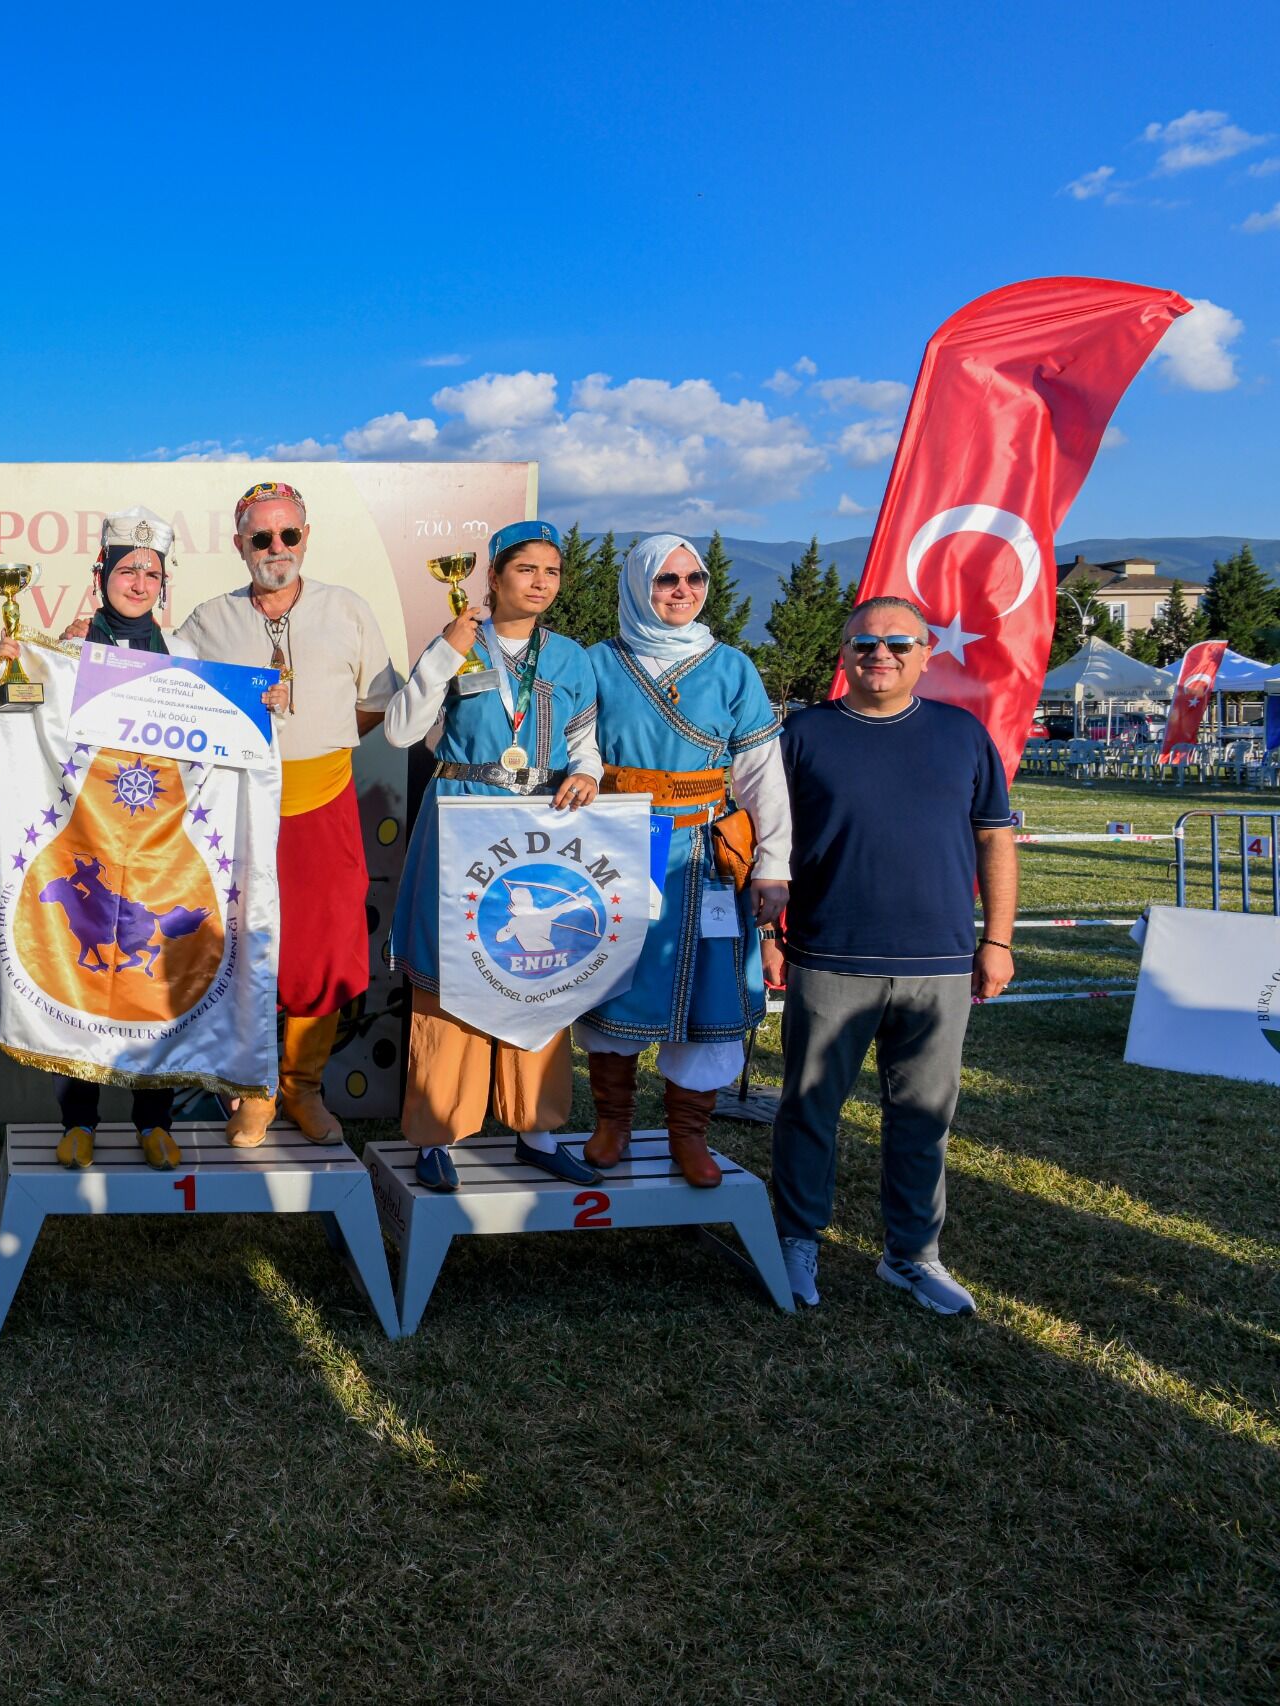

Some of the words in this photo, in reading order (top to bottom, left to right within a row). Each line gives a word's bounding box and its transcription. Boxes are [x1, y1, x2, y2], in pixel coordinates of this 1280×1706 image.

[149, 676, 168, 686] TÜRK
[170, 679, 206, 691] SPORLARI
[158, 685, 194, 698] FESTİVALİ
[168, 711, 197, 724] ÖDÜLÜ
[118, 717, 208, 753] 7.000
[213, 744, 229, 757] TL
[465, 831, 621, 890] ENDAM
[1248, 838, 1263, 857] 4
[471, 950, 523, 1002] GELENEKSEL
[525, 981, 573, 1003] OKÇULUK
[575, 952, 609, 985] KULÜBÜ
[5, 964, 15, 978] ve
[13, 975, 87, 1030] GELENEKSEL
[87, 1022, 157, 1040] OKÇULUK
[160, 1018, 189, 1040] SPOR
[190, 976, 229, 1022] KULÜBÜ
[1257, 984, 1277, 1022] BURSA
[174, 1175, 196, 1210] 1
[573, 1191, 612, 1228] 2
